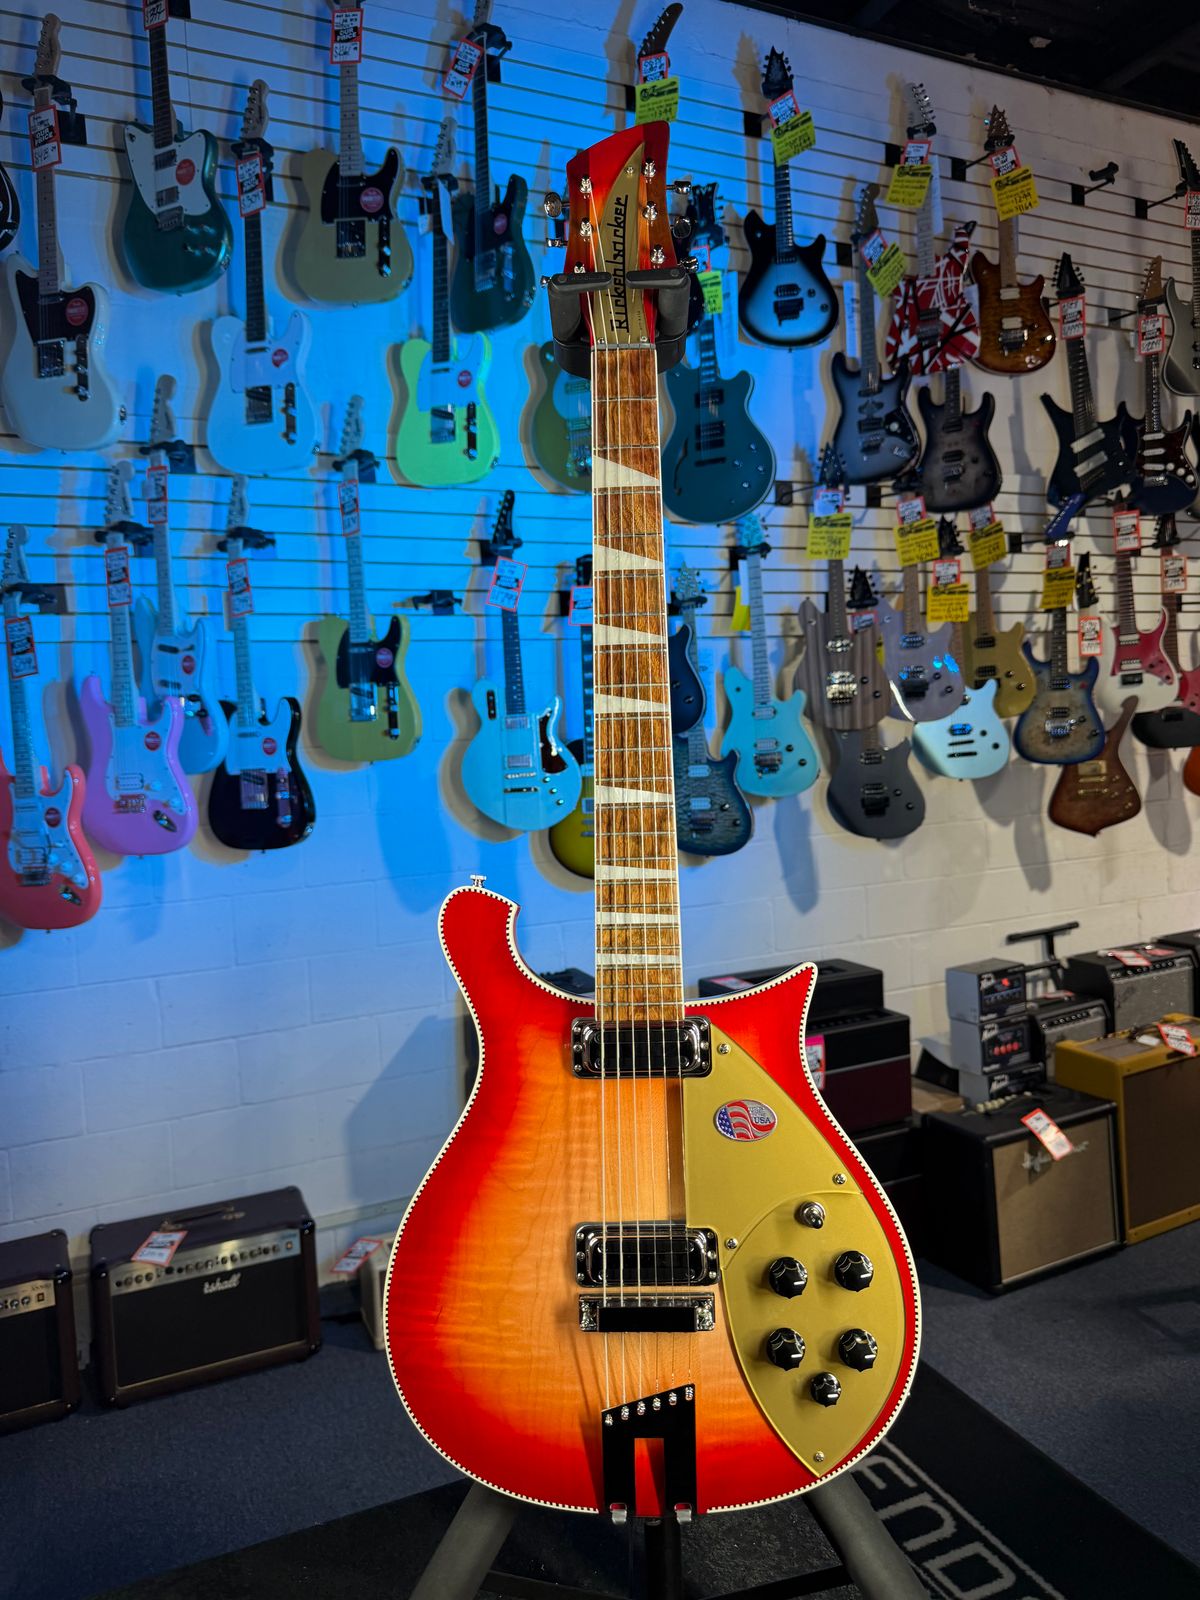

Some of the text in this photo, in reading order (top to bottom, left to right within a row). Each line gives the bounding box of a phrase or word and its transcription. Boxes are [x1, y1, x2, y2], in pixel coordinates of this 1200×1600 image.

[35, 133, 53, 147] PRICE
[36, 128, 50, 140] OUR
[605, 194, 629, 333] Rickenbacker
[754, 1116, 771, 1124] USA
